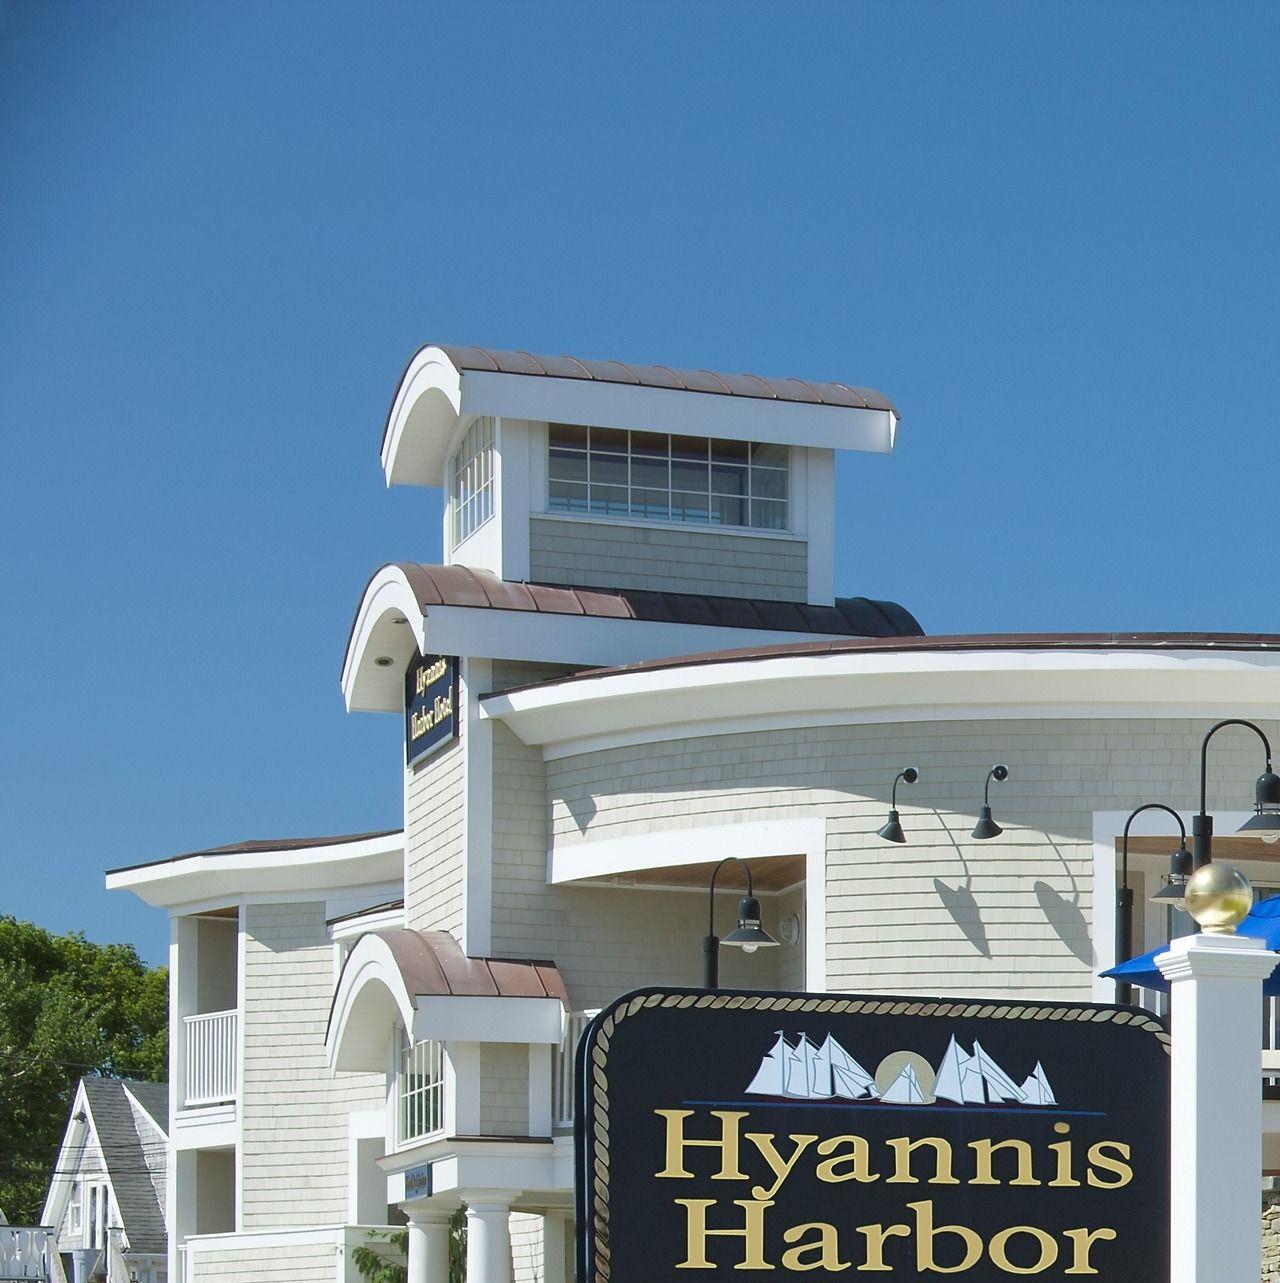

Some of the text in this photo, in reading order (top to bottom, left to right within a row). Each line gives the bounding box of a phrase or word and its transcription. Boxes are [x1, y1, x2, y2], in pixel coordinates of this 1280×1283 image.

[416, 657, 447, 698] Hyannis
[411, 685, 453, 741] Harbor Hotel
[654, 1108, 1134, 1200] Hyannis
[674, 1198, 1117, 1275] Harbor
